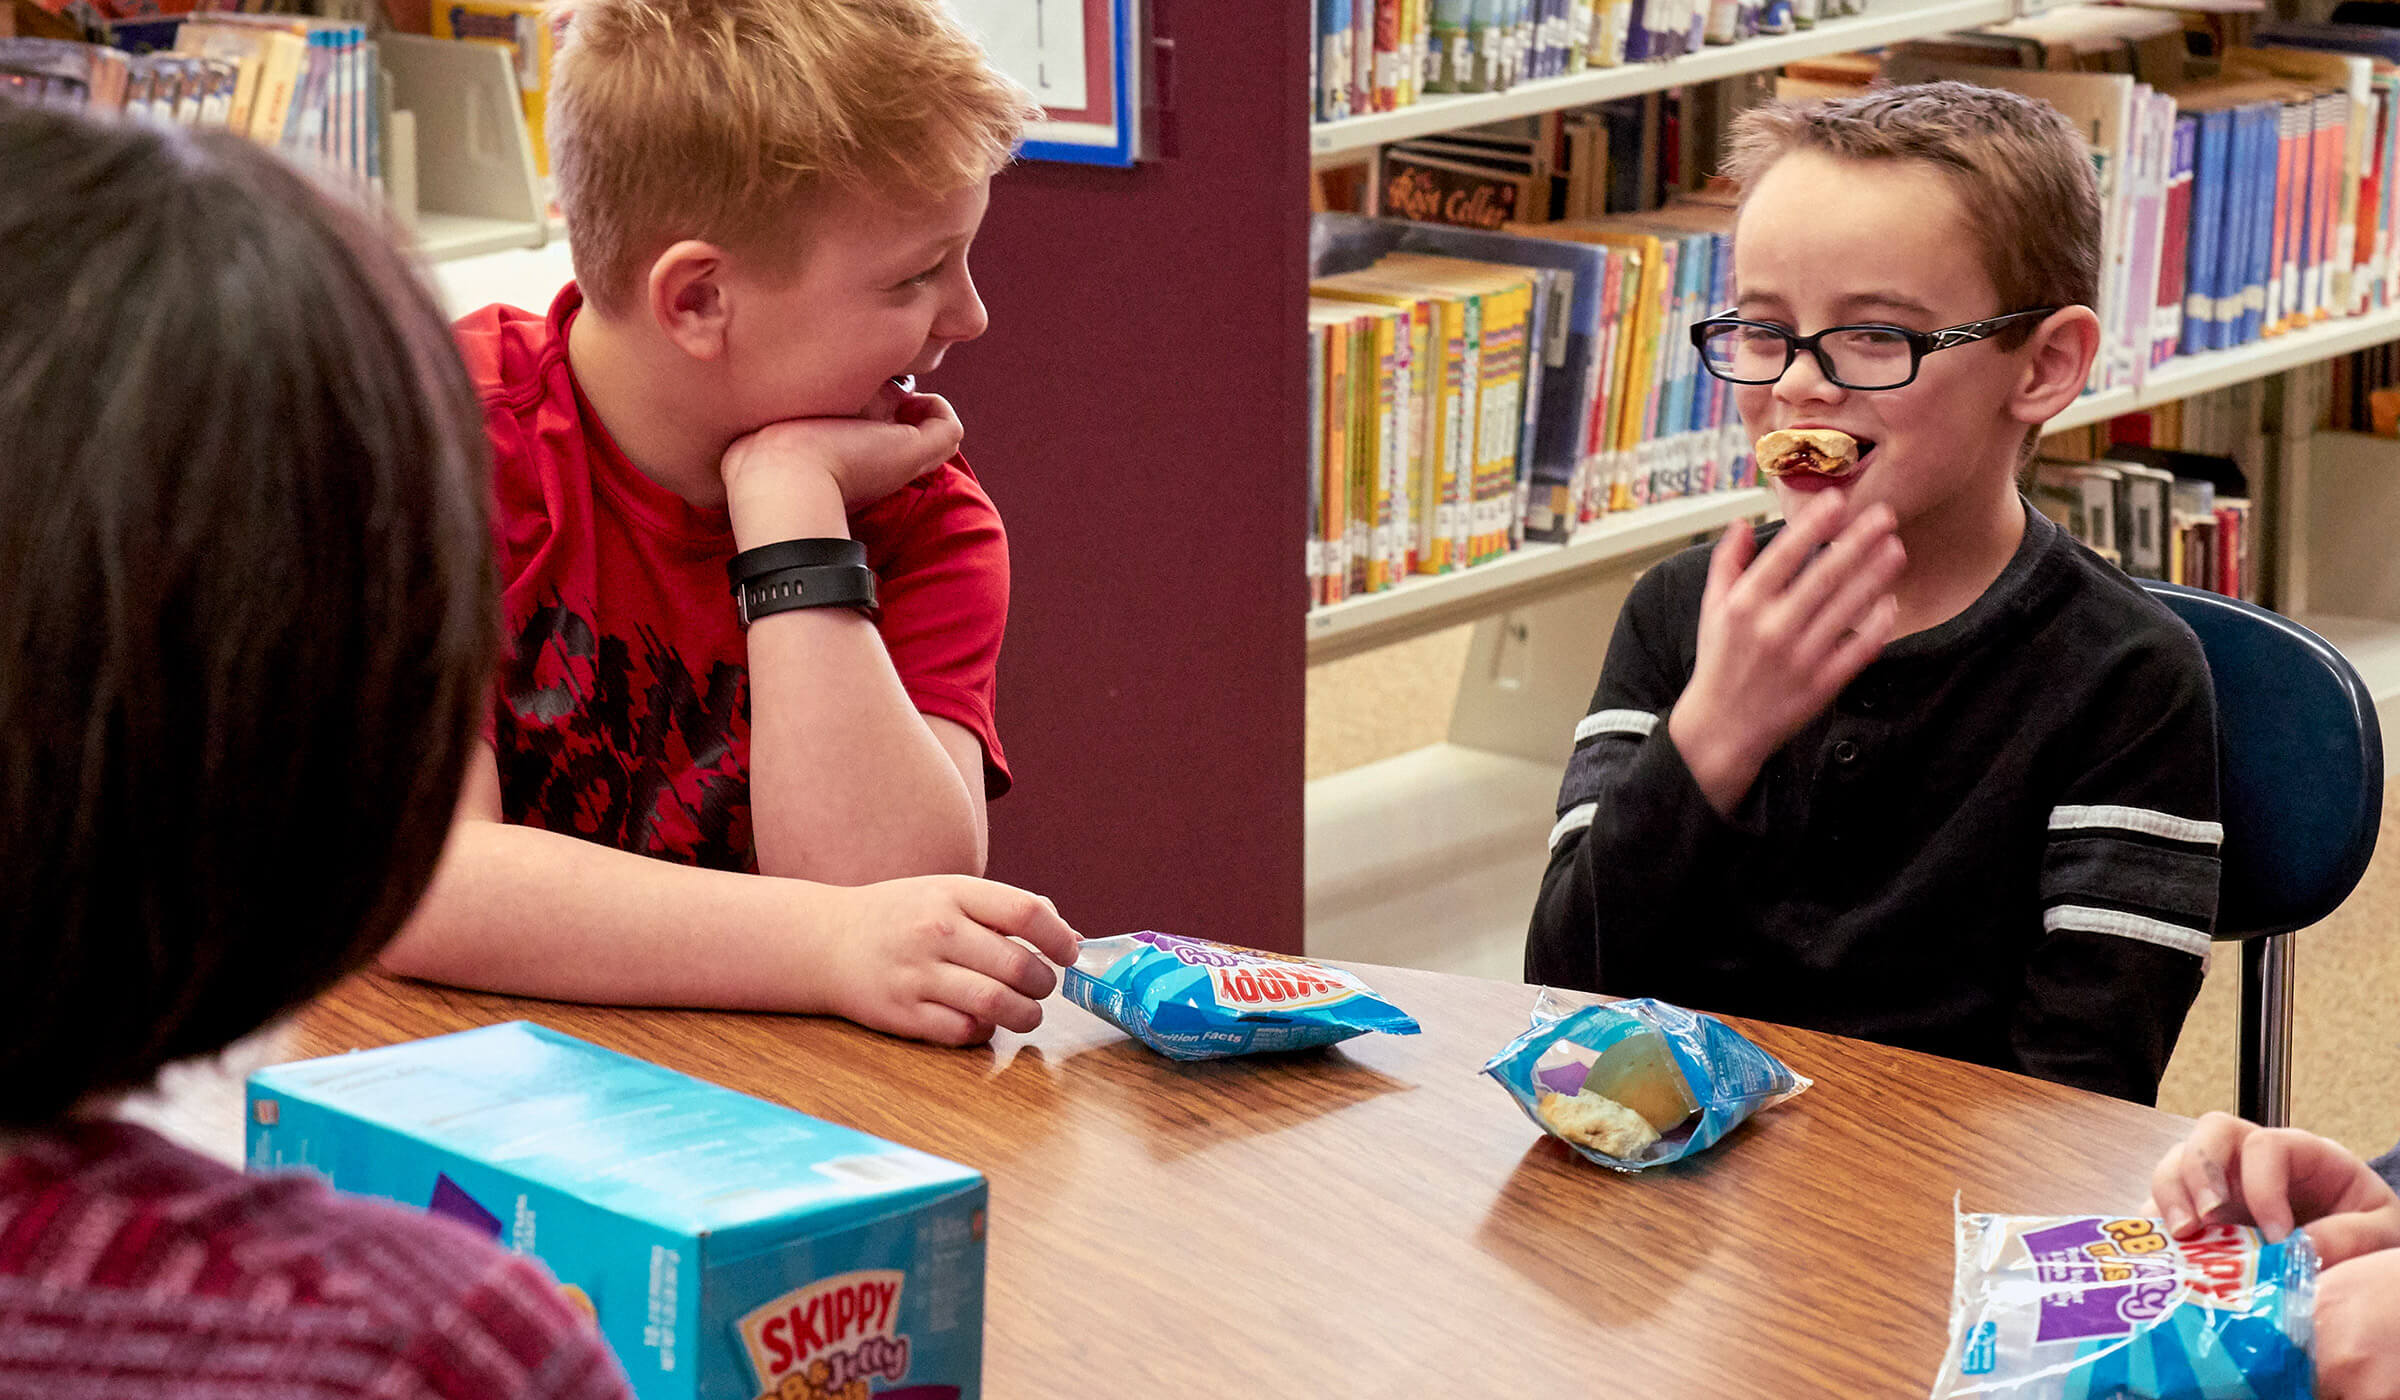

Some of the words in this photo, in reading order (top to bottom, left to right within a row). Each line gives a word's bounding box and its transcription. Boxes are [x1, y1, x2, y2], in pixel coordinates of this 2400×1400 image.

[1201, 1031, 1242, 1043] Facts
[761, 1282, 898, 1375] SKIPPY
[826, 1336, 908, 1392] Jelly
